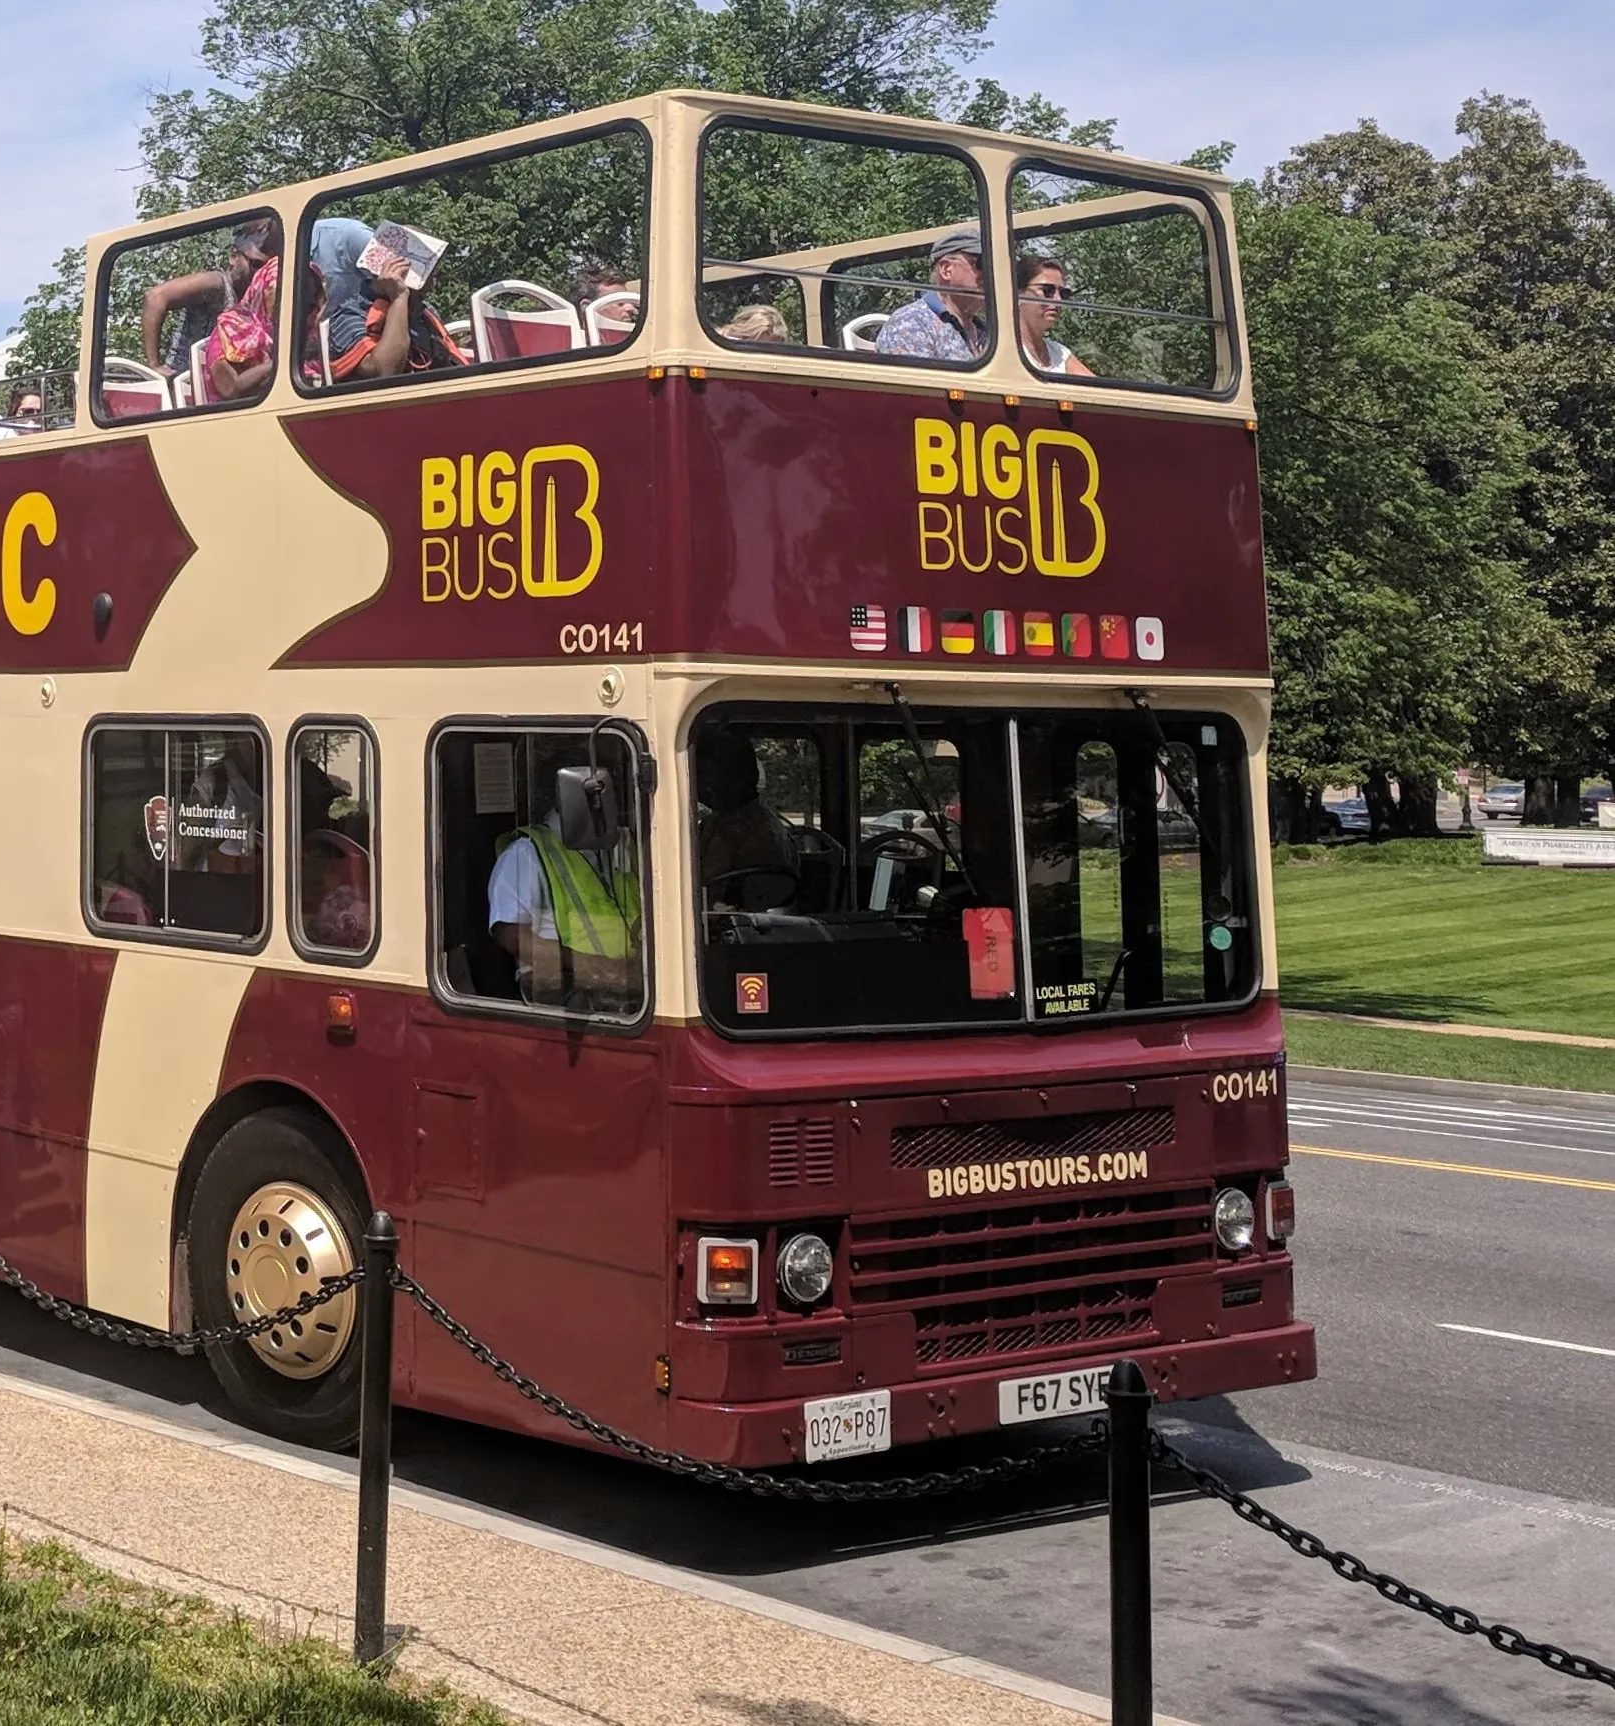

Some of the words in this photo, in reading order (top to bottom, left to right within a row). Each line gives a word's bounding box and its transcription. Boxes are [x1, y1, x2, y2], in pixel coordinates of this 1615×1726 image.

[915, 418, 1023, 500] BIG
[421, 450, 517, 531] BIG
[918, 501, 1028, 575] BUS
[421, 532, 517, 602] BUS
[178, 803, 236, 820] Authorized
[178, 822, 247, 840] Concessioner
[1036, 985, 1066, 1000] LOCAL
[1067, 982, 1096, 997] FARES
[1044, 999, 1090, 1015] AVAILABLE
[927, 1151, 1148, 1199] BIGBUSTOURS.COM
[1017, 1379, 1062, 1415] F67
